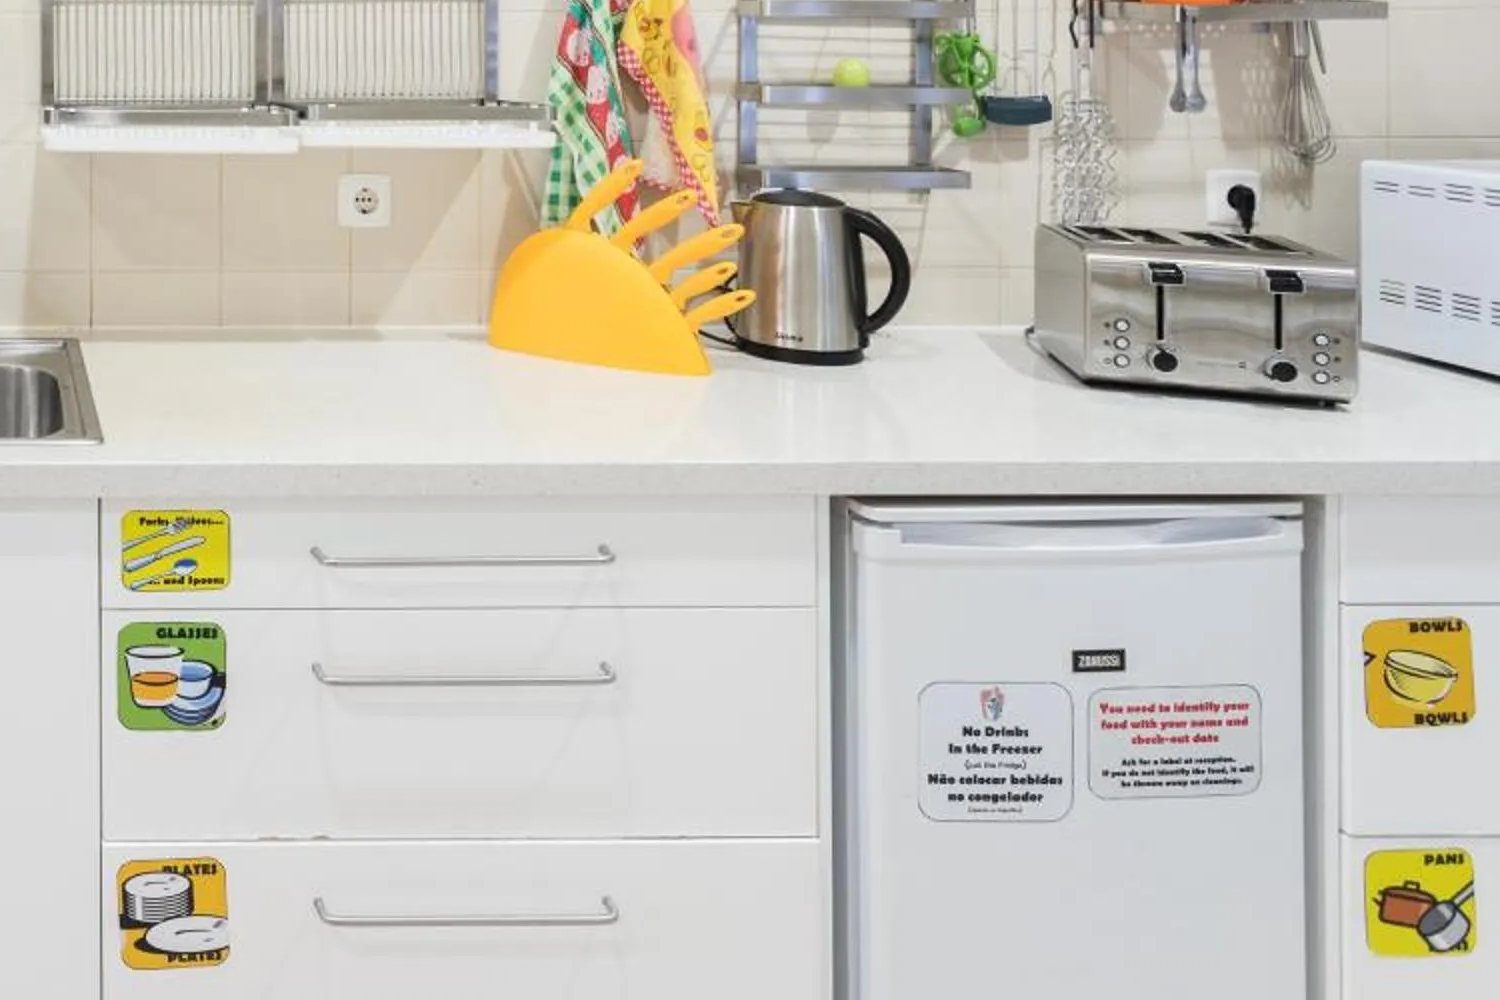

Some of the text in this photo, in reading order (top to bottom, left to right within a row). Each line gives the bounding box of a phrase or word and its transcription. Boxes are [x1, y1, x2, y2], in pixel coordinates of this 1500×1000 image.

[1409, 619, 1463, 633] BOWLS
[156, 627, 218, 639] GLASSES
[1100, 702, 1123, 714] You
[1127, 702, 1155, 714] need
[1173, 701, 1220, 714] identify
[1223, 702, 1249, 713] your
[1101, 716, 1249, 731] food with your name and
[1414, 712, 1468, 726] BOWLS
[962, 726, 1029, 738] No Drinks
[1131, 732, 1219, 745] check-out date
[948, 743, 1043, 754] In the Freezer
[928, 773, 1063, 785] Não colocar bebidas
[948, 791, 1044, 804] no congelador
[1424, 853, 1464, 866] PANS
